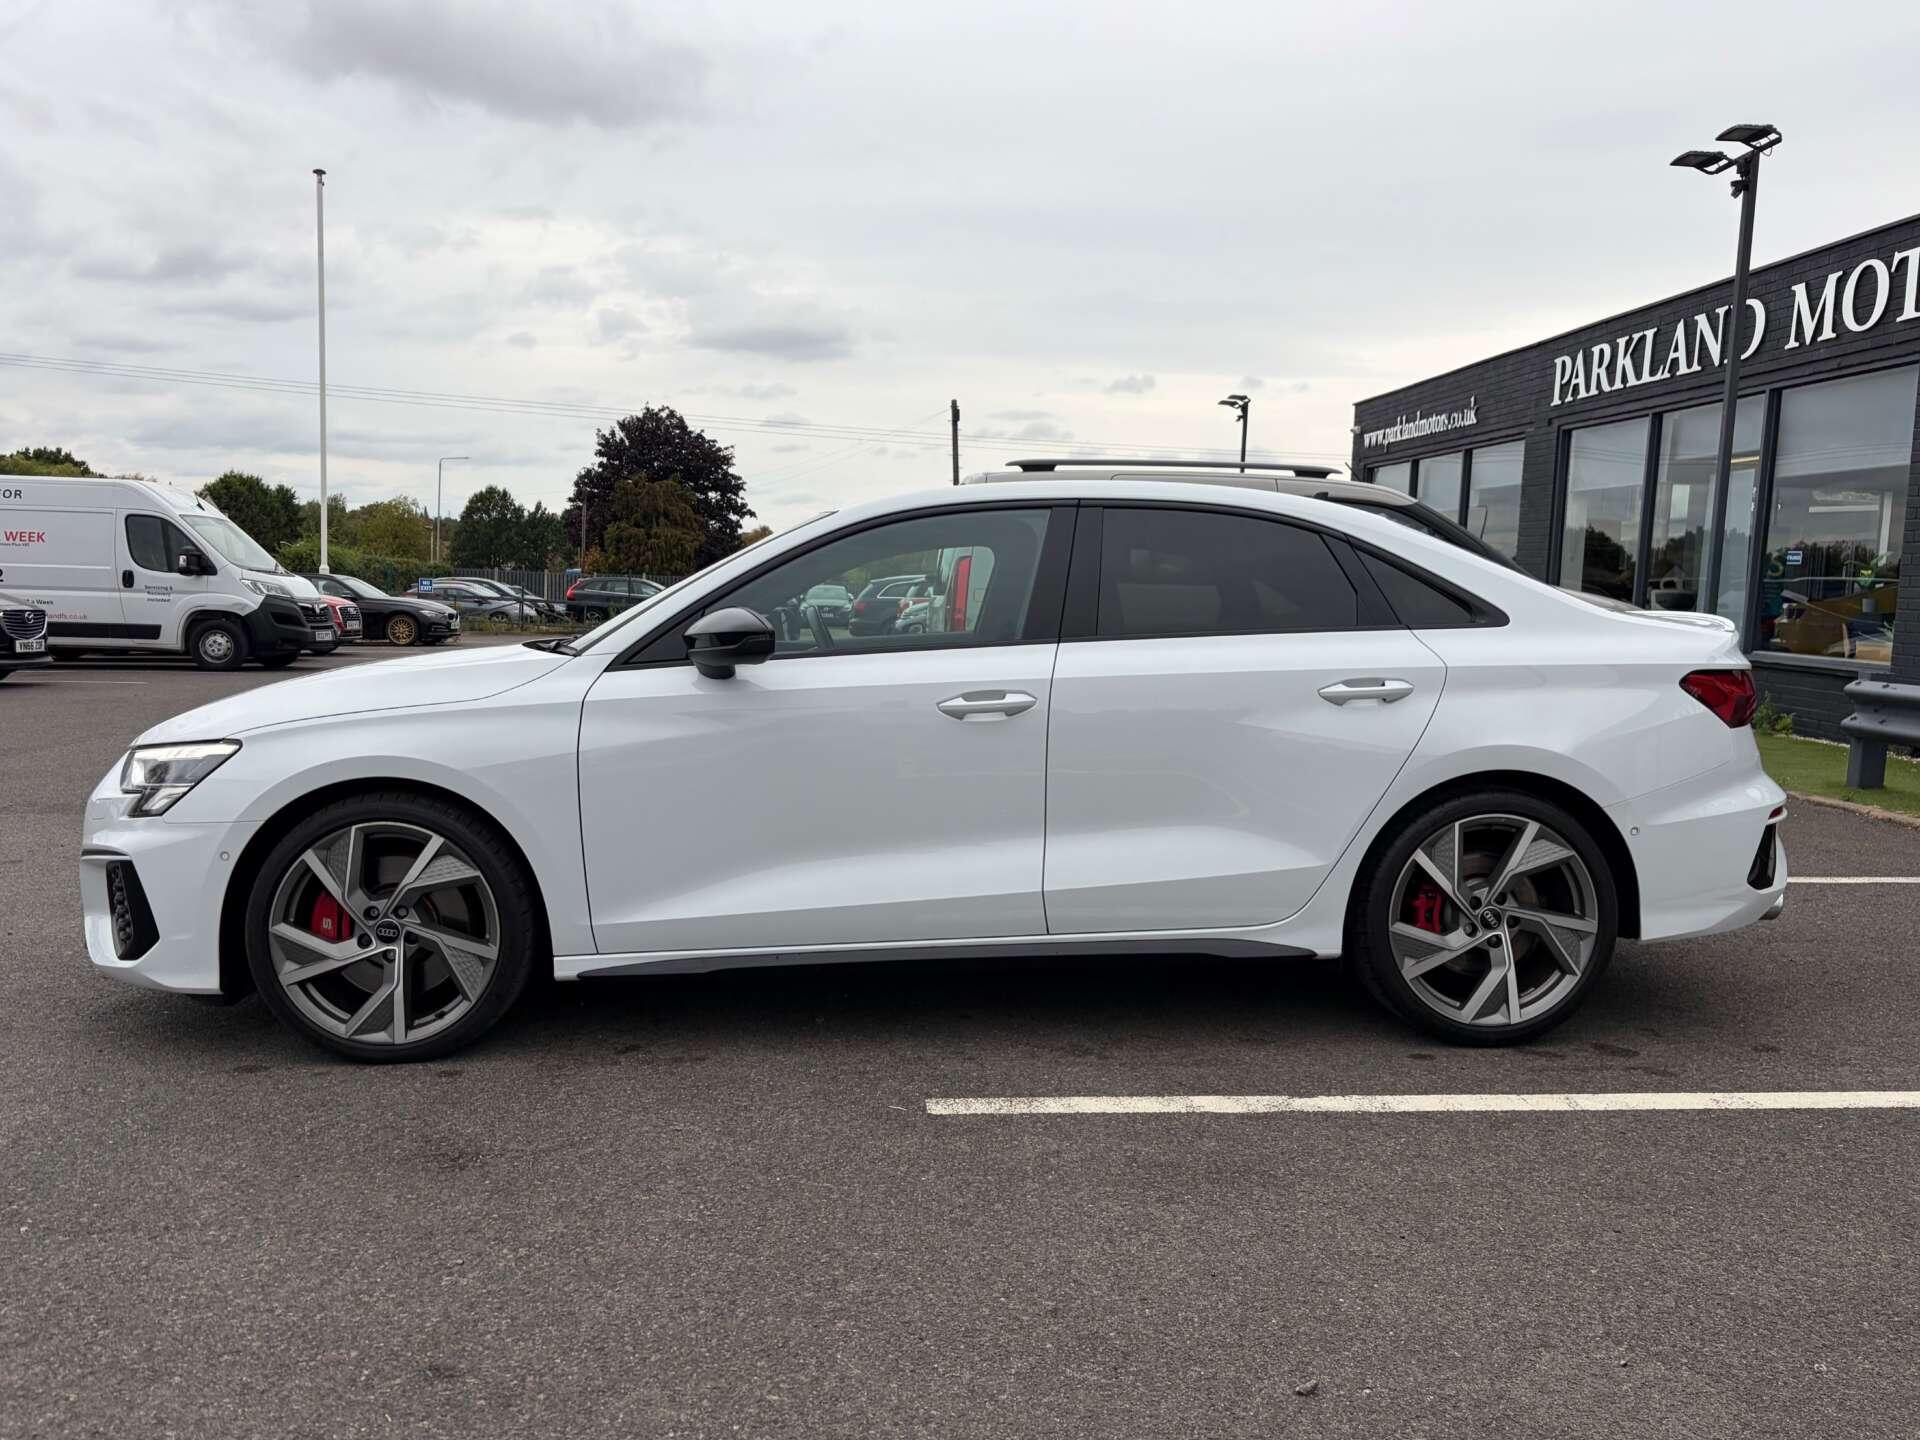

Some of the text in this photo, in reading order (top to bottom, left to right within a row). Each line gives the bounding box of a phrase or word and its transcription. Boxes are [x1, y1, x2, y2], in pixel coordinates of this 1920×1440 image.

[1550, 298, 1766, 407] PARKLAND
[1363, 395, 1478, 453] www.parklandmotors.co.uk
[0, 488, 22, 500] OR
[4, 531, 46, 543] WEEK
